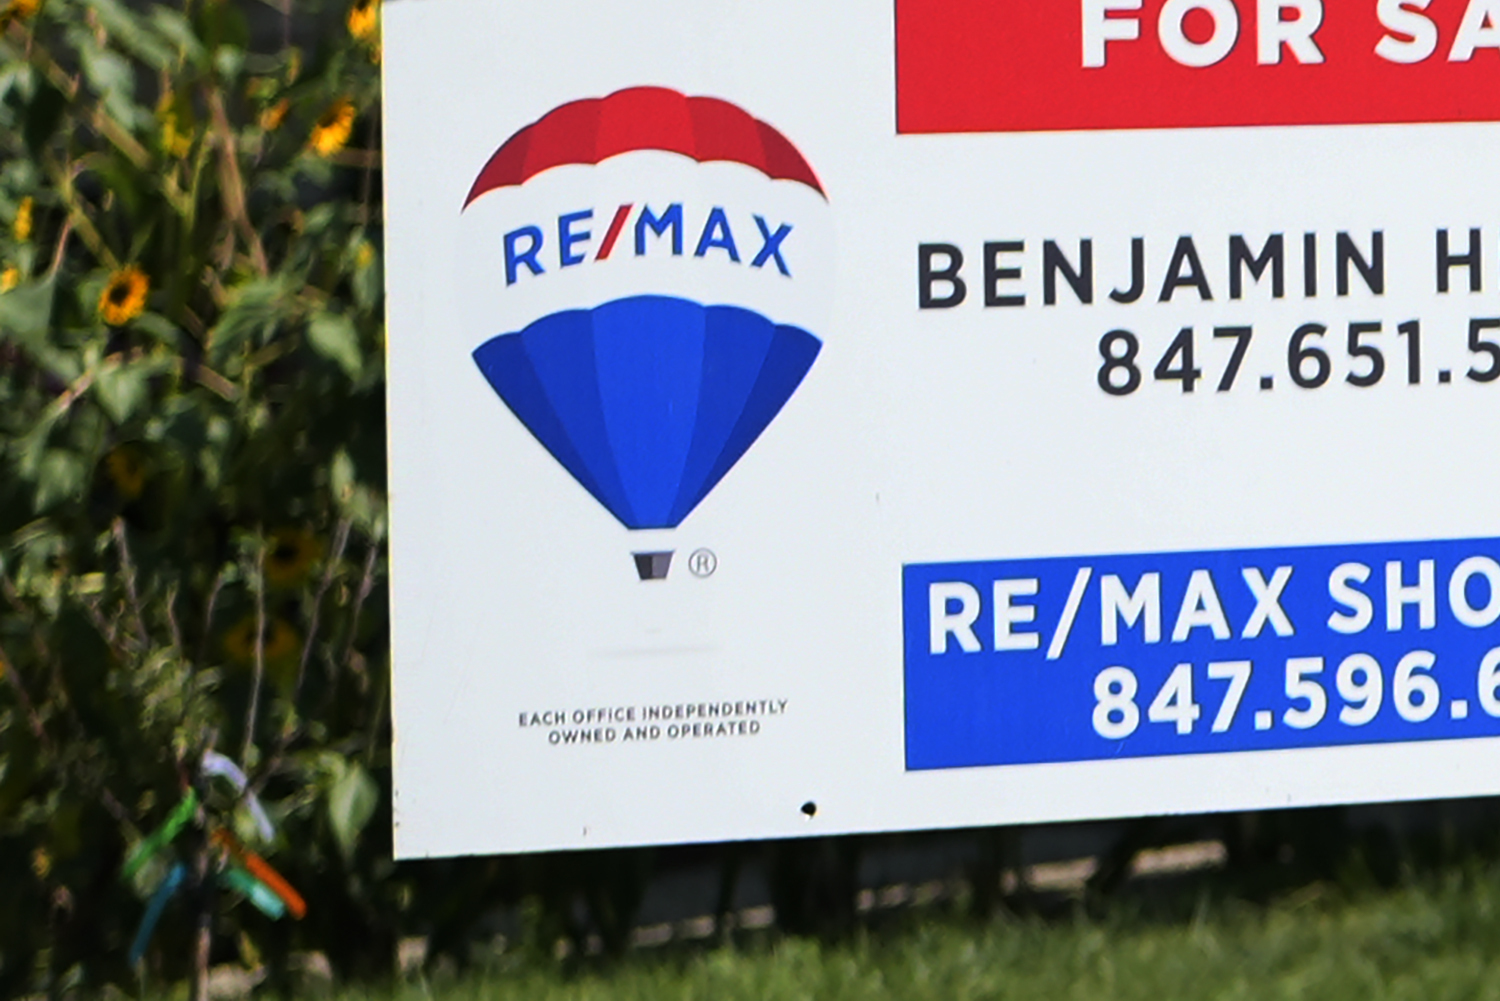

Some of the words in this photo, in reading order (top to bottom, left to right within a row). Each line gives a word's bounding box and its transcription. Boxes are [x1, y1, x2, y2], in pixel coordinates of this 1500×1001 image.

[502, 202, 795, 288] RE/MAX
[917, 230, 1387, 310] BENJAMIN
[927, 564, 1297, 658] RE/MAX
[519, 711, 566, 727] EACH
[572, 705, 637, 724] OFFICE
[642, 699, 788, 720] INDEPENDENTLY
[547, 727, 617, 746] OWNED
[622, 724, 663, 742] AND
[666, 719, 761, 740] OPERATED
